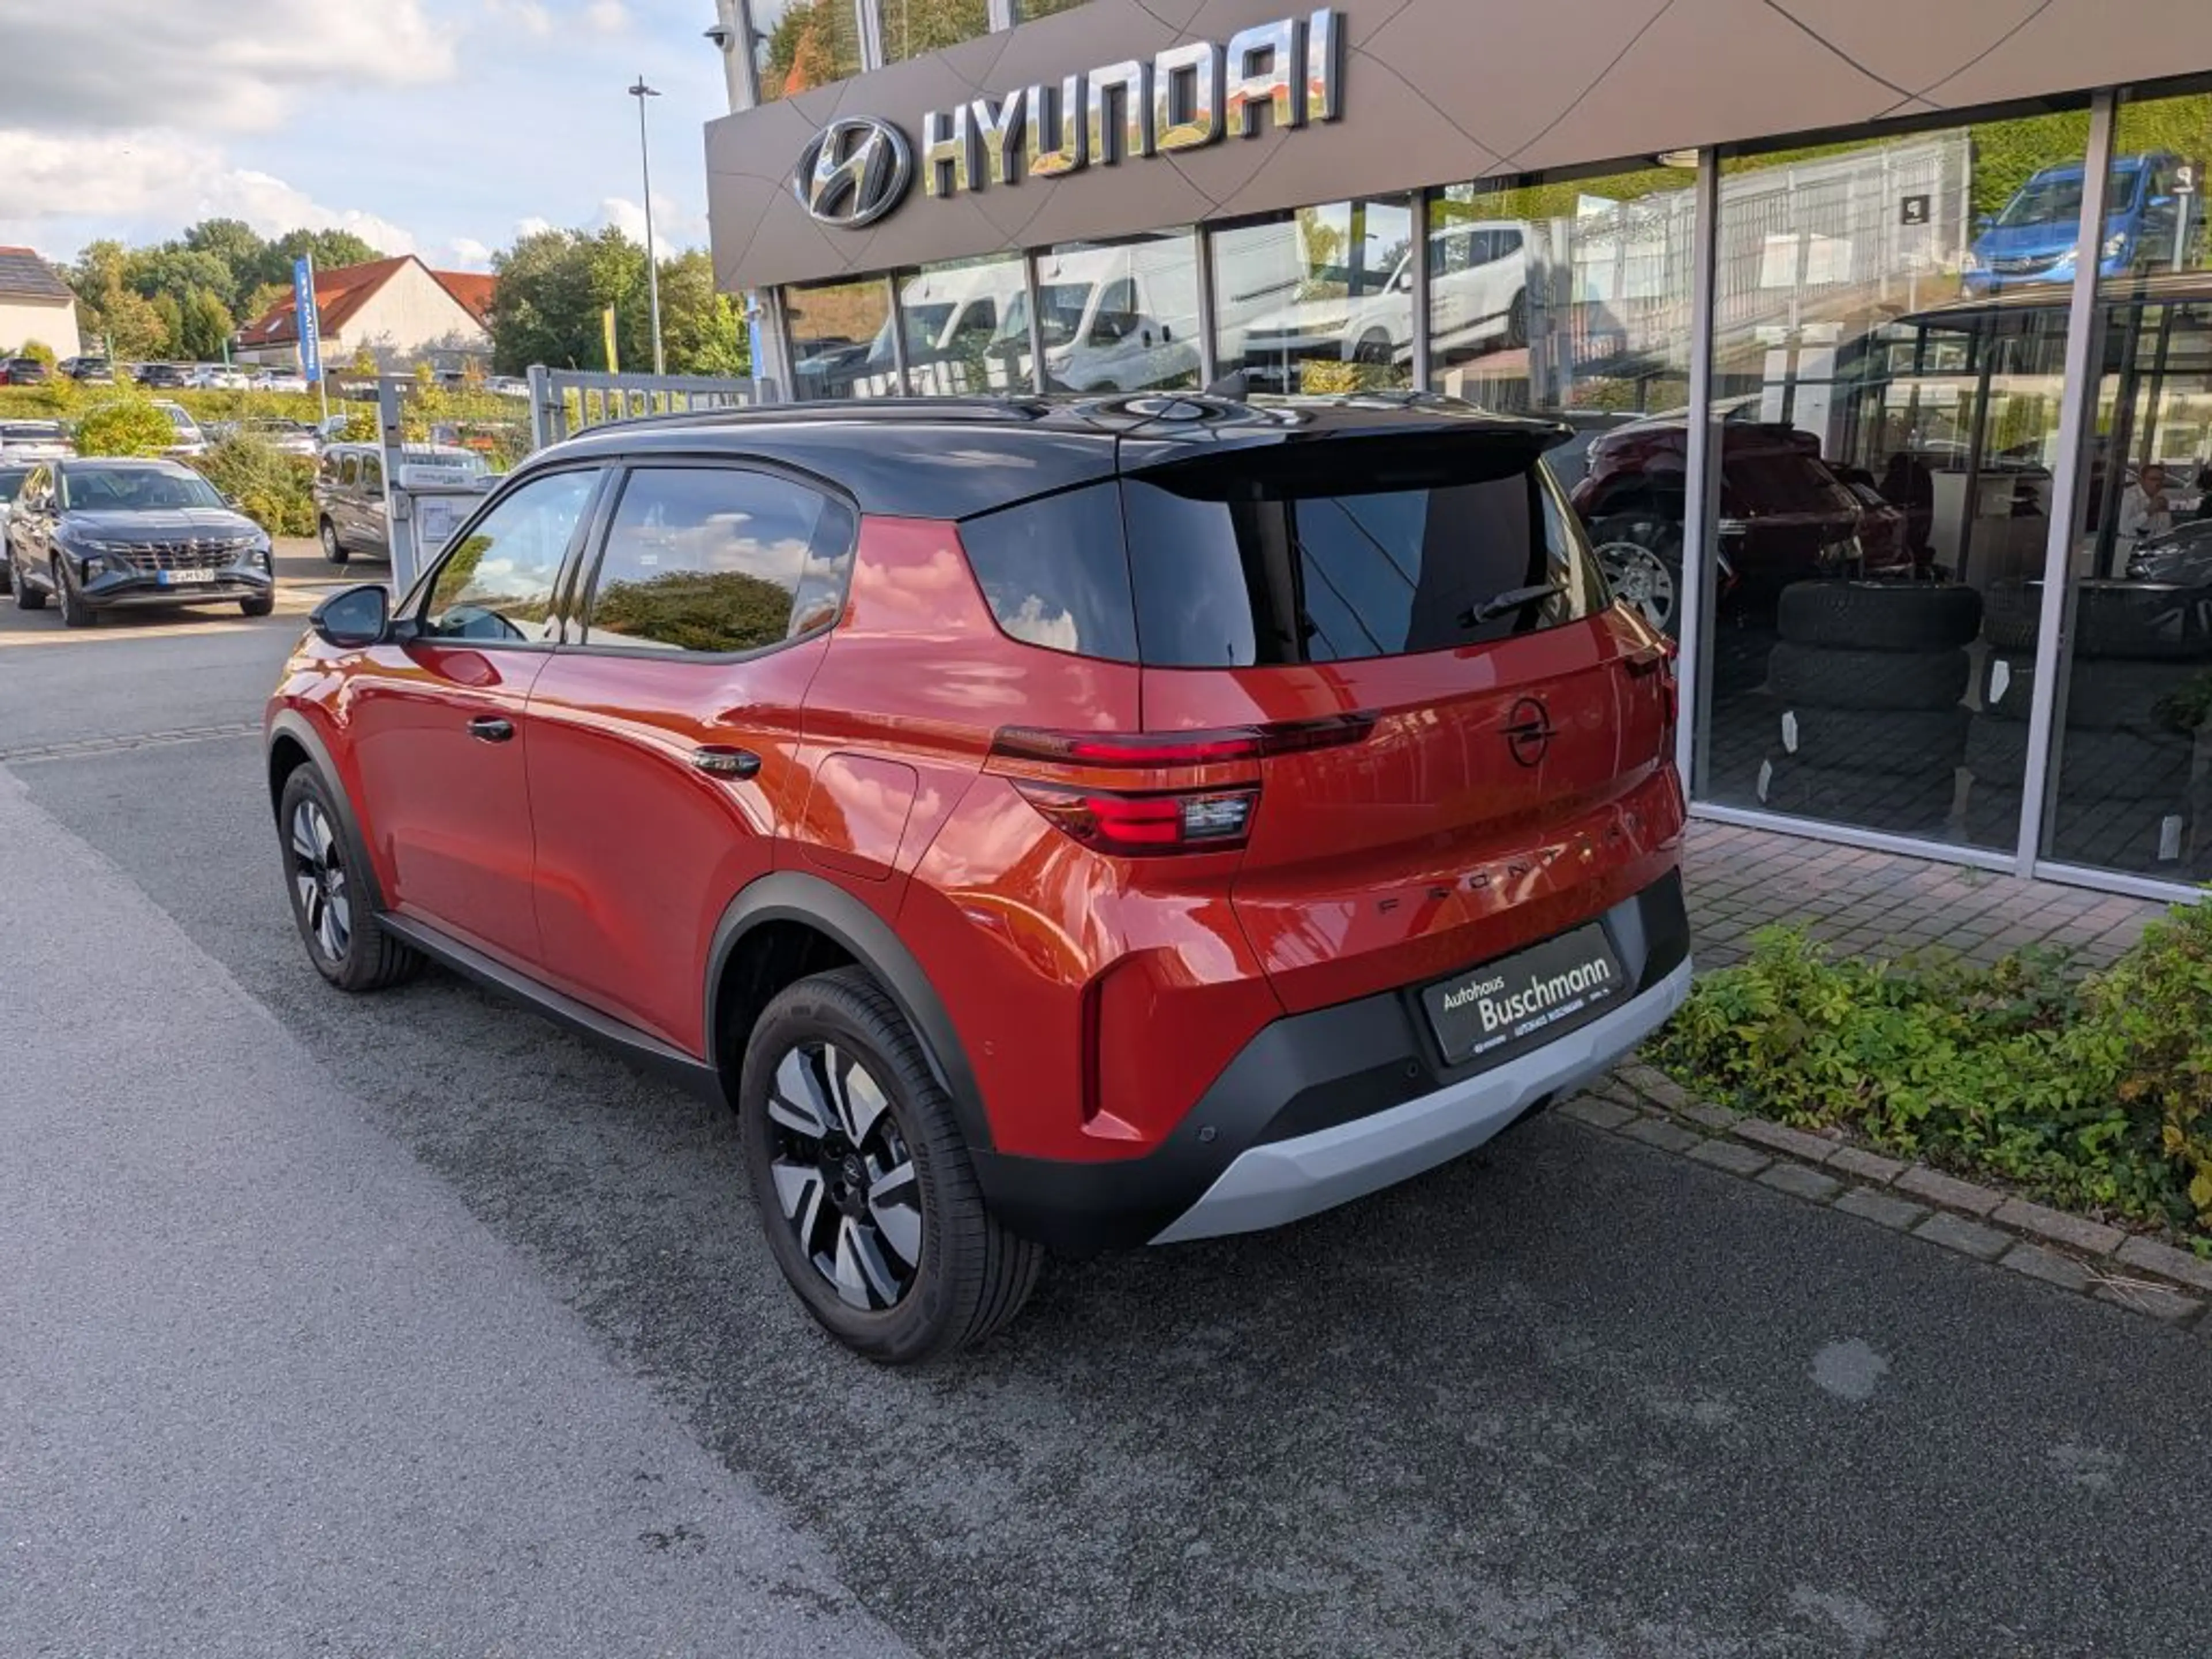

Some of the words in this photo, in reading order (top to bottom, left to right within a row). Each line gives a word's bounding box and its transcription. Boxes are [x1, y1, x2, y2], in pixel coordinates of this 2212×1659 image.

[923, 8, 1343, 199] HYUNDAI
[1379, 812, 1642, 915] FRONT
[1444, 976, 1505, 1011] Autohaus
[1477, 957, 1611, 1032] Buschmann
